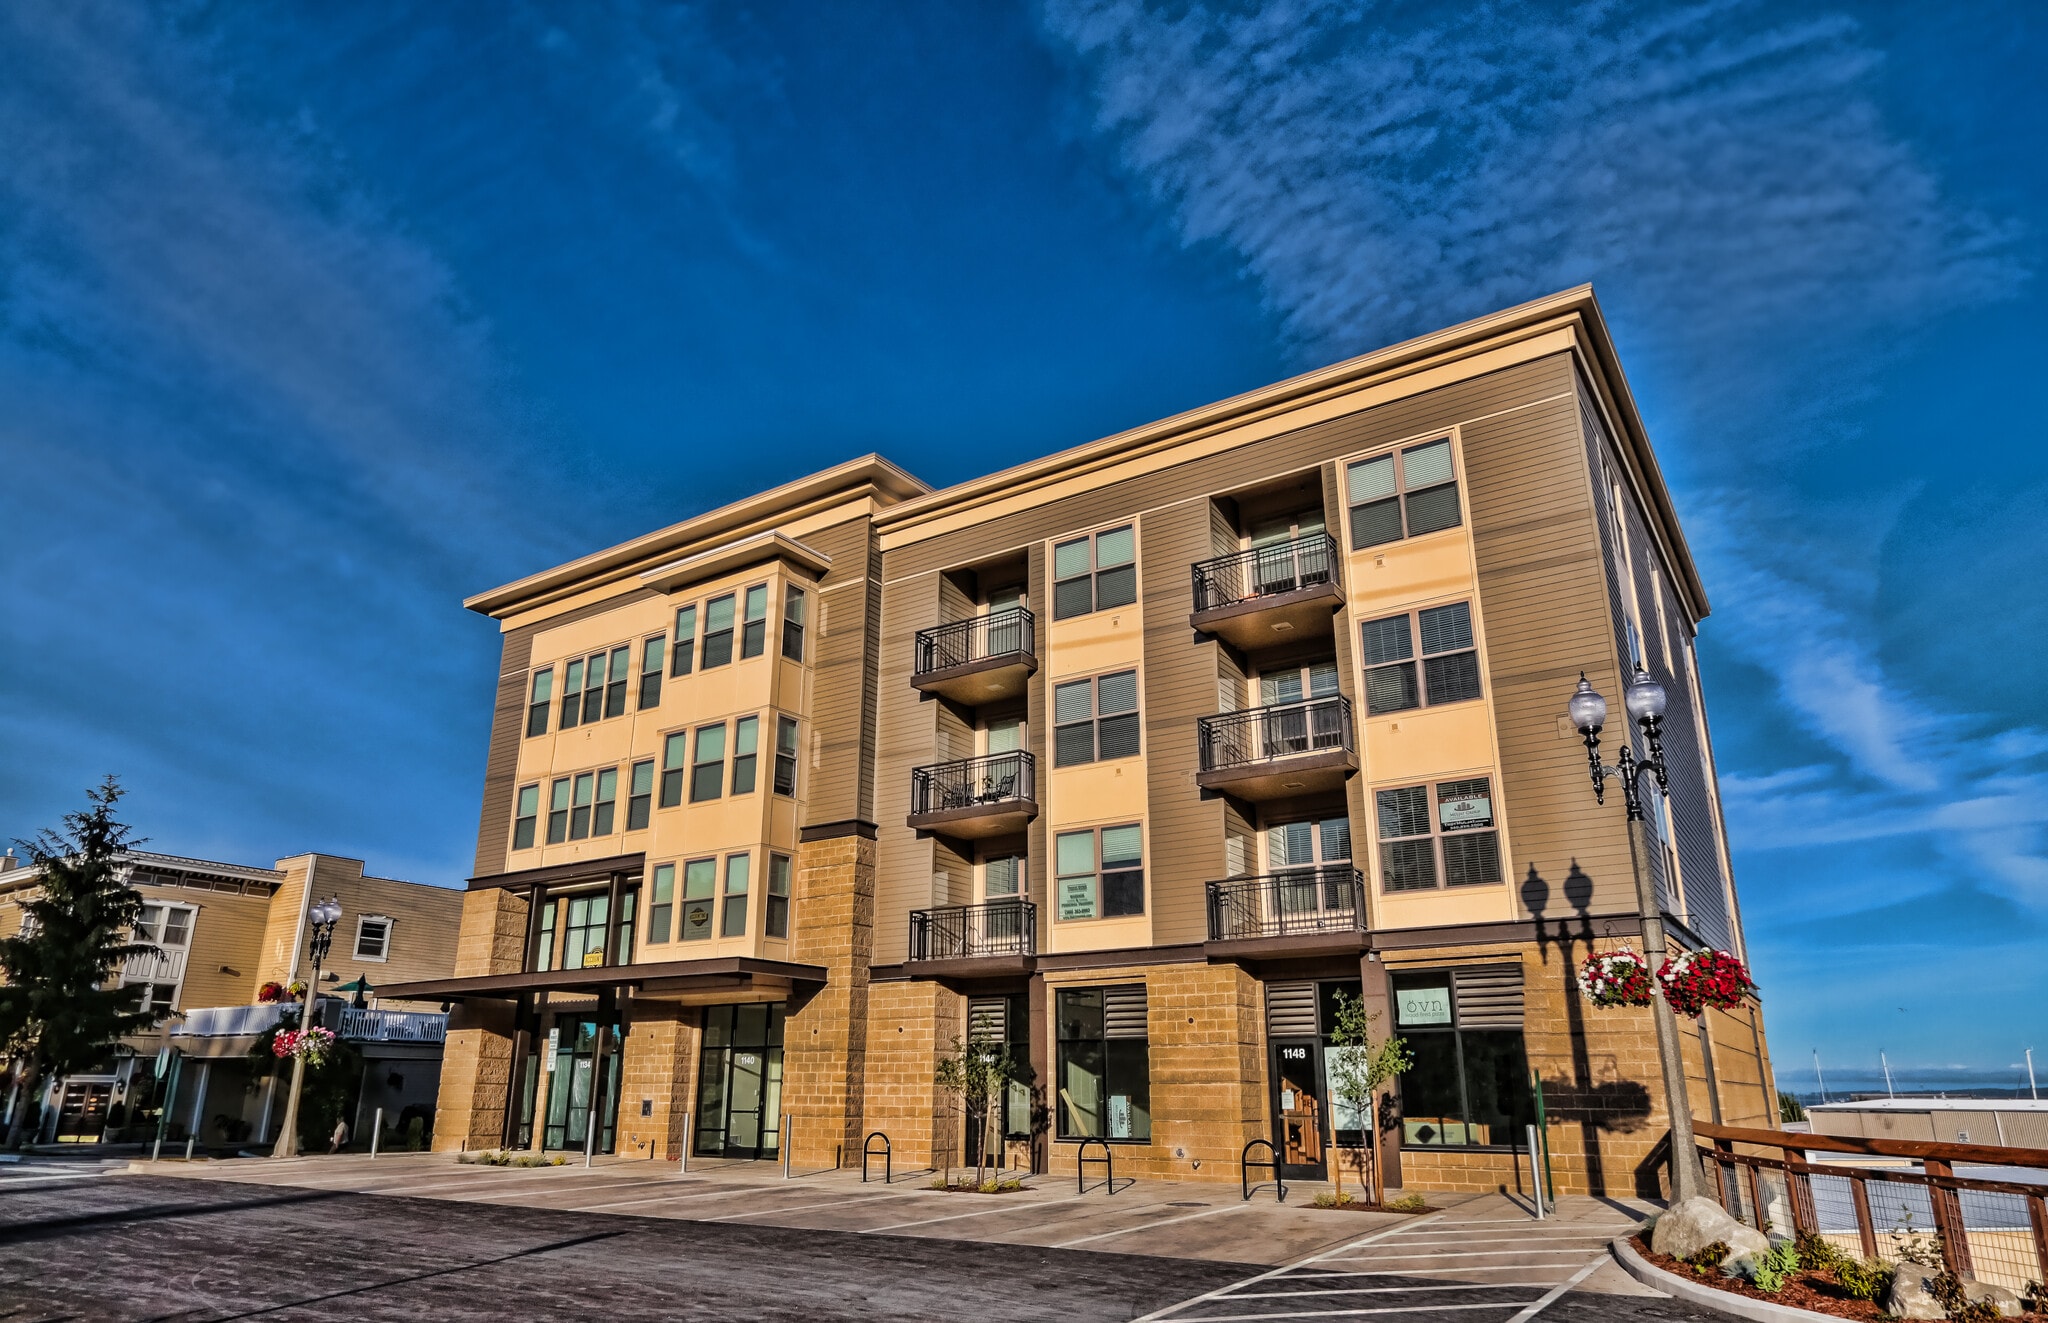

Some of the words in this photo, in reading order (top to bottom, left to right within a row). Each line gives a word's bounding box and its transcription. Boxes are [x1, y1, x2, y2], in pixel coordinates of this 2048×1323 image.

[1444, 793, 1483, 803] AVAILABLE
[1406, 1000, 1443, 1013] övn
[1282, 1047, 1306, 1059] 1148
[580, 1060, 591, 1069] 1134
[741, 1056, 755, 1065] 1140
